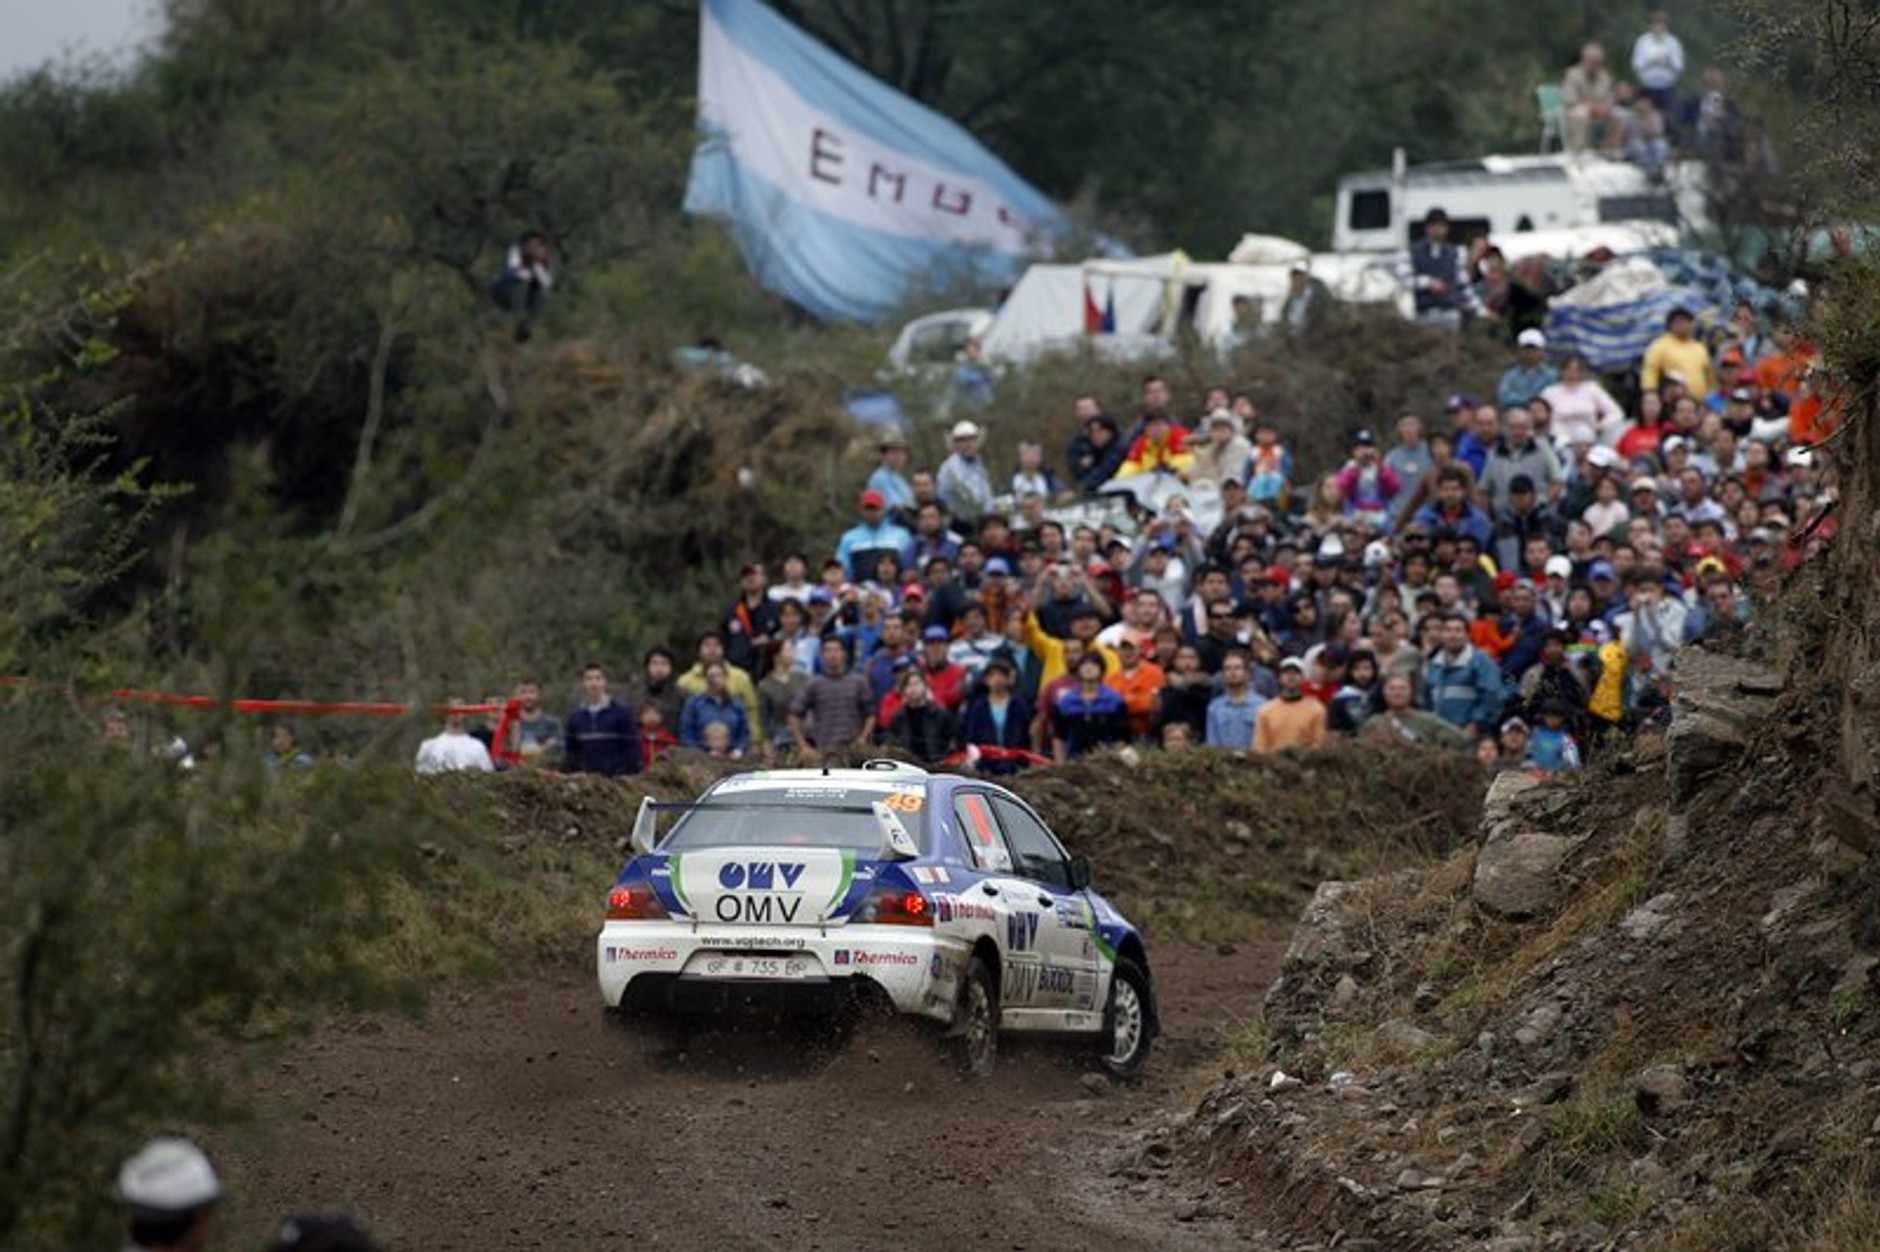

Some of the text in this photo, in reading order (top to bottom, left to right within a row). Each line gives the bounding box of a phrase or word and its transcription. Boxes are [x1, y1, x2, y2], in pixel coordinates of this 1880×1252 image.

[719, 862, 805, 889] OMV
[716, 895, 802, 922] OMV
[619, 947, 678, 960] Thermico
[853, 951, 918, 965] Thermico
